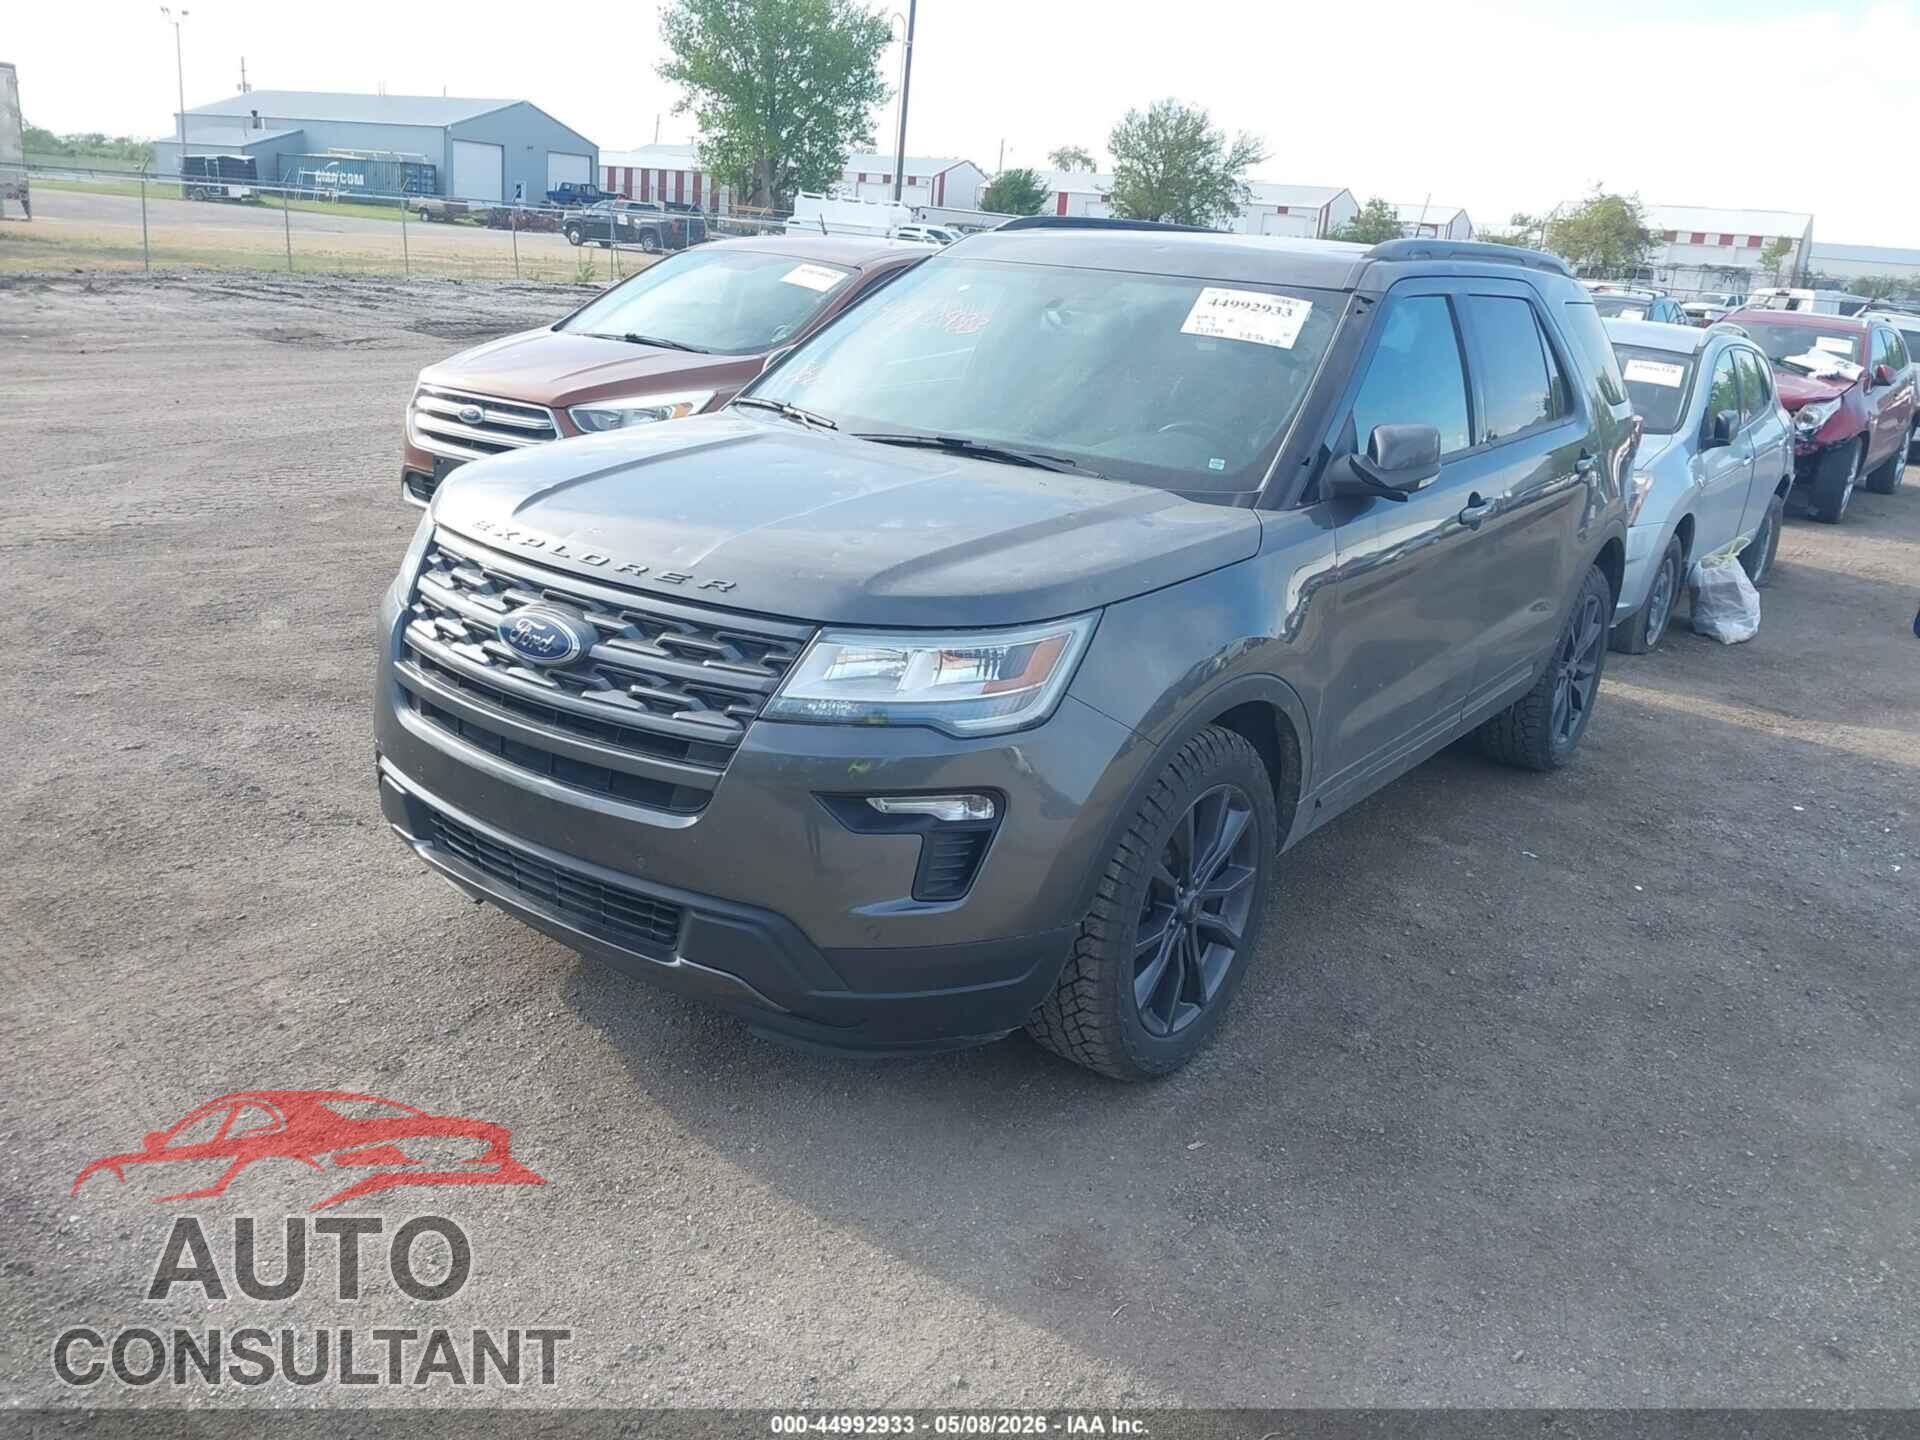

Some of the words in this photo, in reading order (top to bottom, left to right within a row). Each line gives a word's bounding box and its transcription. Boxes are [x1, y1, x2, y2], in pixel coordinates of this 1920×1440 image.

[1207, 297, 1294, 319] 44992933
[472, 519, 737, 594] EXPLORER
[508, 617, 557, 653] Ford
